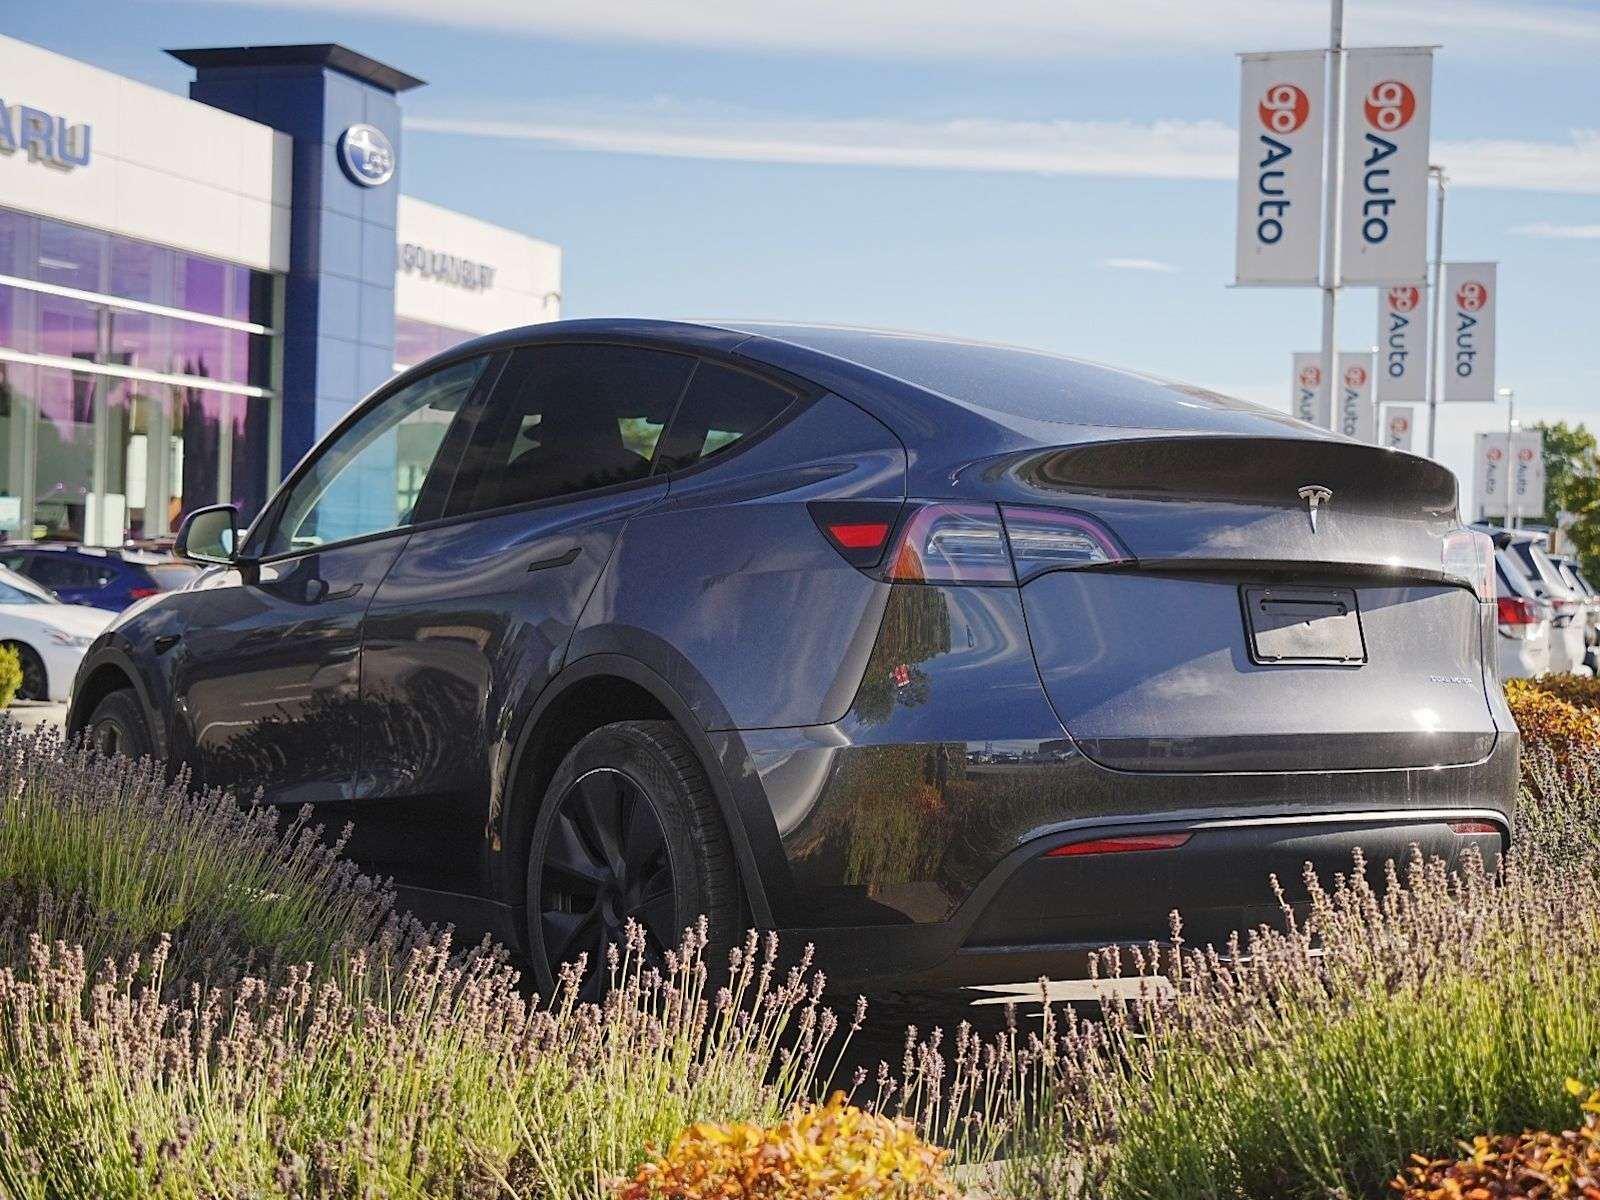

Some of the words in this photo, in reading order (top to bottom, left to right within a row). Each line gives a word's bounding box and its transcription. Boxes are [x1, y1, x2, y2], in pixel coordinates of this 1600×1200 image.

[1258, 84, 1298, 134] go
[1364, 80, 1404, 131] go
[1257, 135, 1293, 245] Auto
[1362, 133, 1398, 244] Auto
[1388, 312, 1410, 378] Auto
[1456, 312, 1477, 378] Auto
